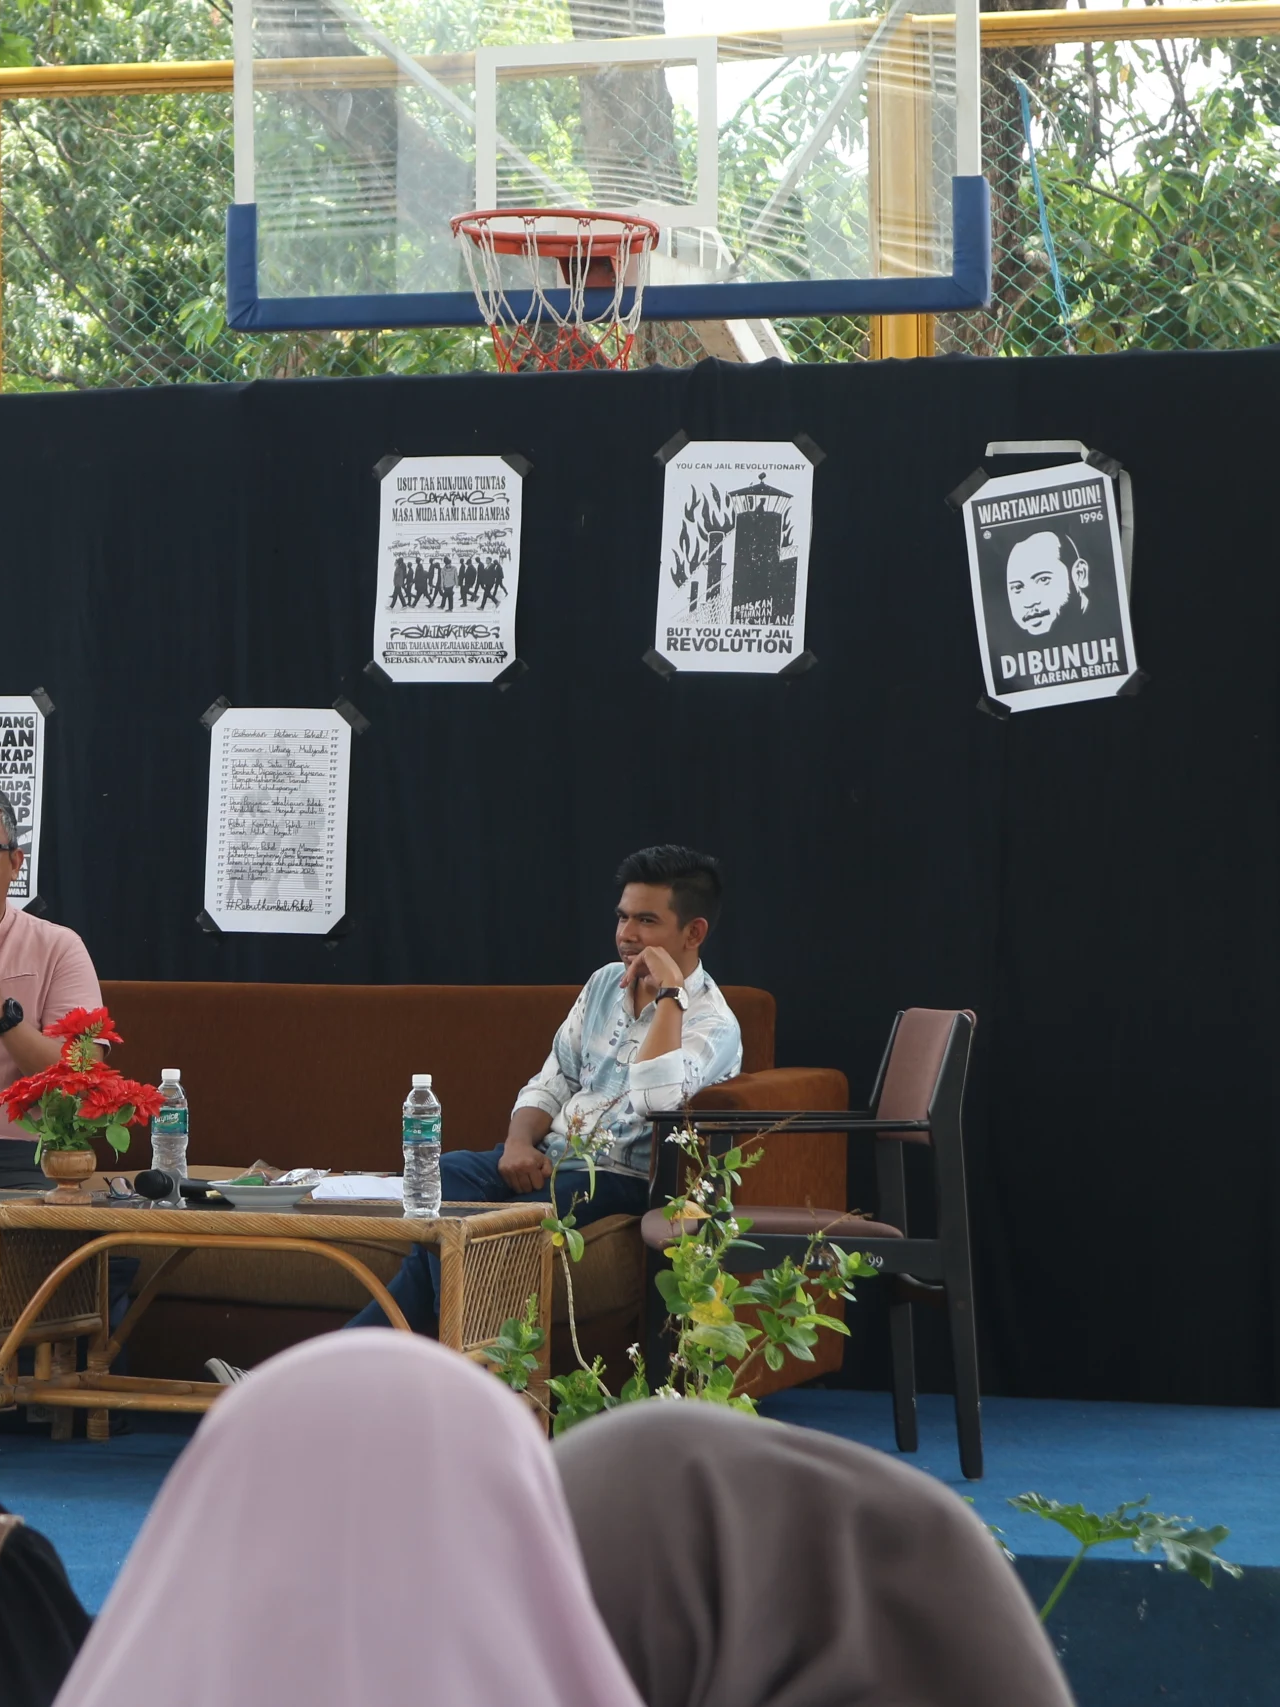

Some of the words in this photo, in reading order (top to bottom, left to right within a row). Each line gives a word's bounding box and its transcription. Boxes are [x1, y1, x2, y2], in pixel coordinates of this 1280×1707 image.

[397, 477, 418, 491] USUT
[420, 476, 434, 490] TAK
[436, 476, 472, 490] KUNJUNG
[475, 476, 506, 490] TUNTAS
[978, 492, 1060, 524] WARTAWAN
[1062, 484, 1102, 508] UDIN!
[392, 508, 414, 522] MASA
[416, 507, 438, 522] MUDA
[440, 507, 459, 522] KAMI
[461, 506, 478, 521] KAU
[478, 506, 510, 521] RAMPAS
[1080, 510, 1104, 524] 1996
[666, 628, 692, 636] BUT
[696, 628, 721, 637] YOU
[725, 628, 762, 638] CAN'T
[765, 630, 793, 638] JAIL
[386, 642, 408, 650] UNTUK
[410, 642, 440, 650] TAHANAN
[440, 642, 470, 650] PEJUANG
[471, 642, 504, 650] KEADILAN
[666, 638, 792, 654] REVOLUTION
[1000, 637, 1118, 679] DIBUNUH
[1034, 668, 1078, 686] KARENA
[1081, 662, 1120, 678] BERITA
